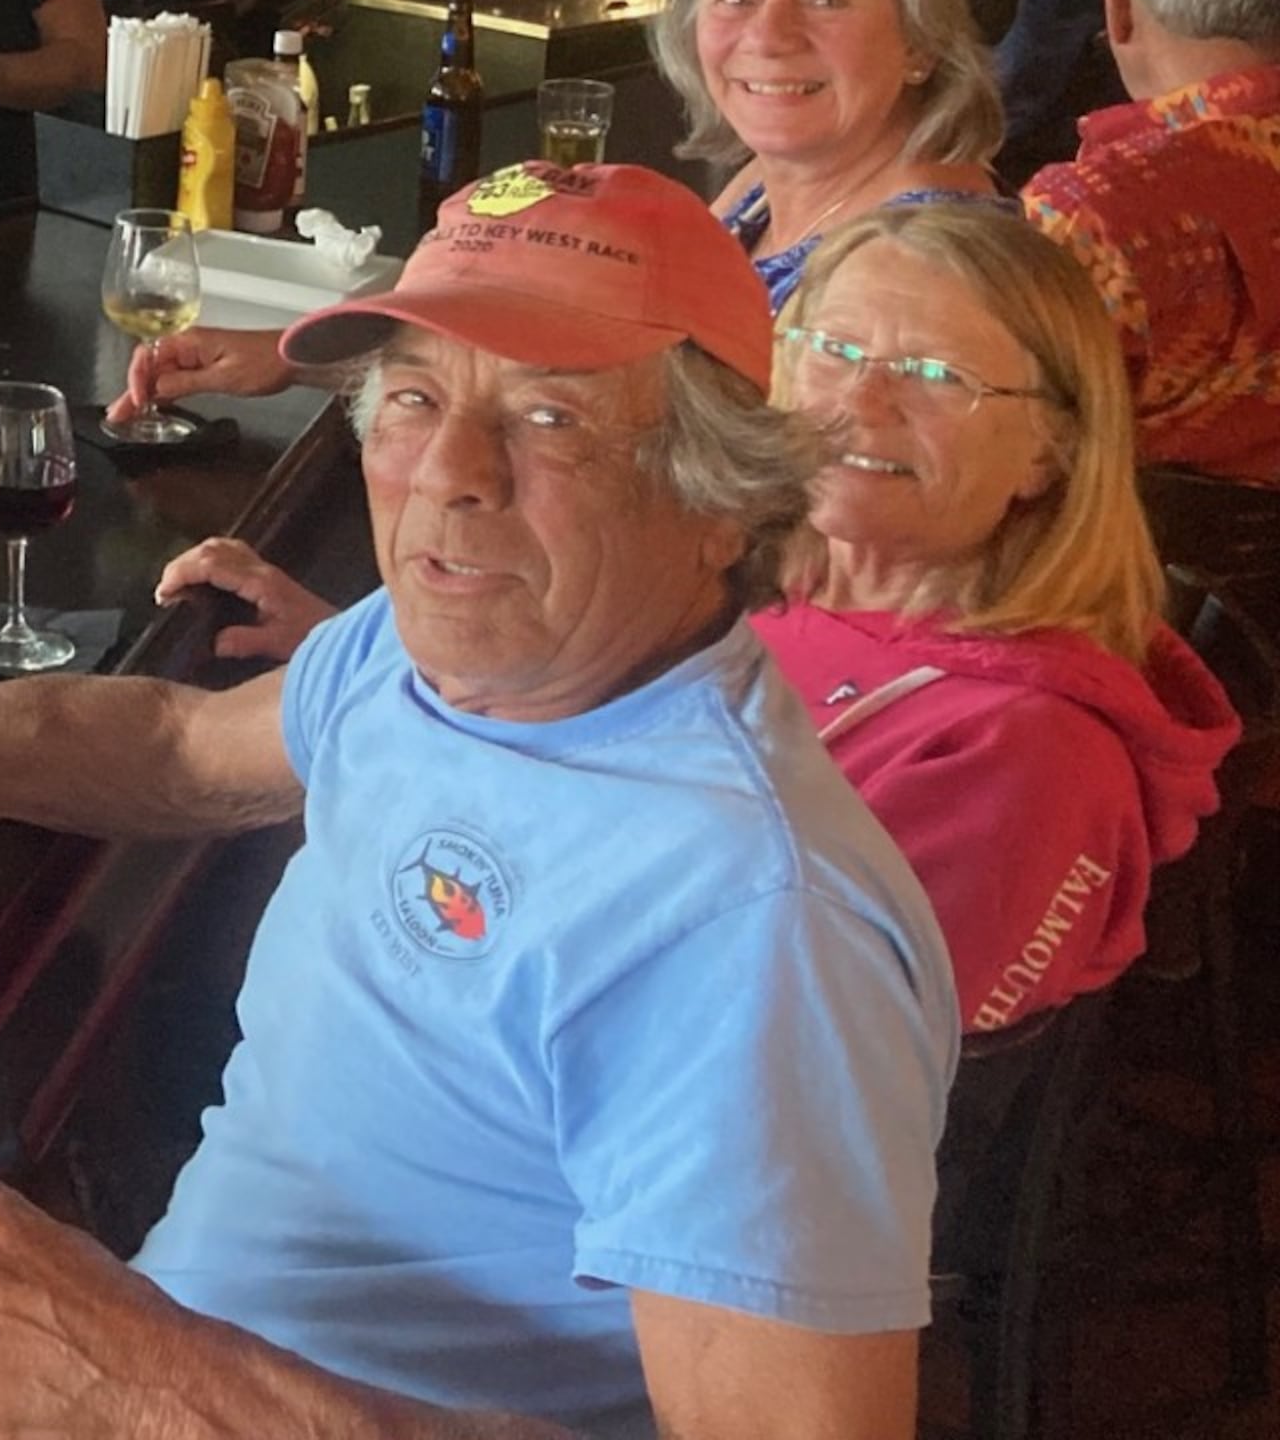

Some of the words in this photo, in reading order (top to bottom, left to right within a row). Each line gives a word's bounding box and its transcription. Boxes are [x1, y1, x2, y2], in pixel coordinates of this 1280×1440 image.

[483, 223, 524, 242] KEY
[525, 229, 585, 251] WEST
[585, 241, 640, 265] RACE
[973, 853, 1112, 1033] FALMOUTH
